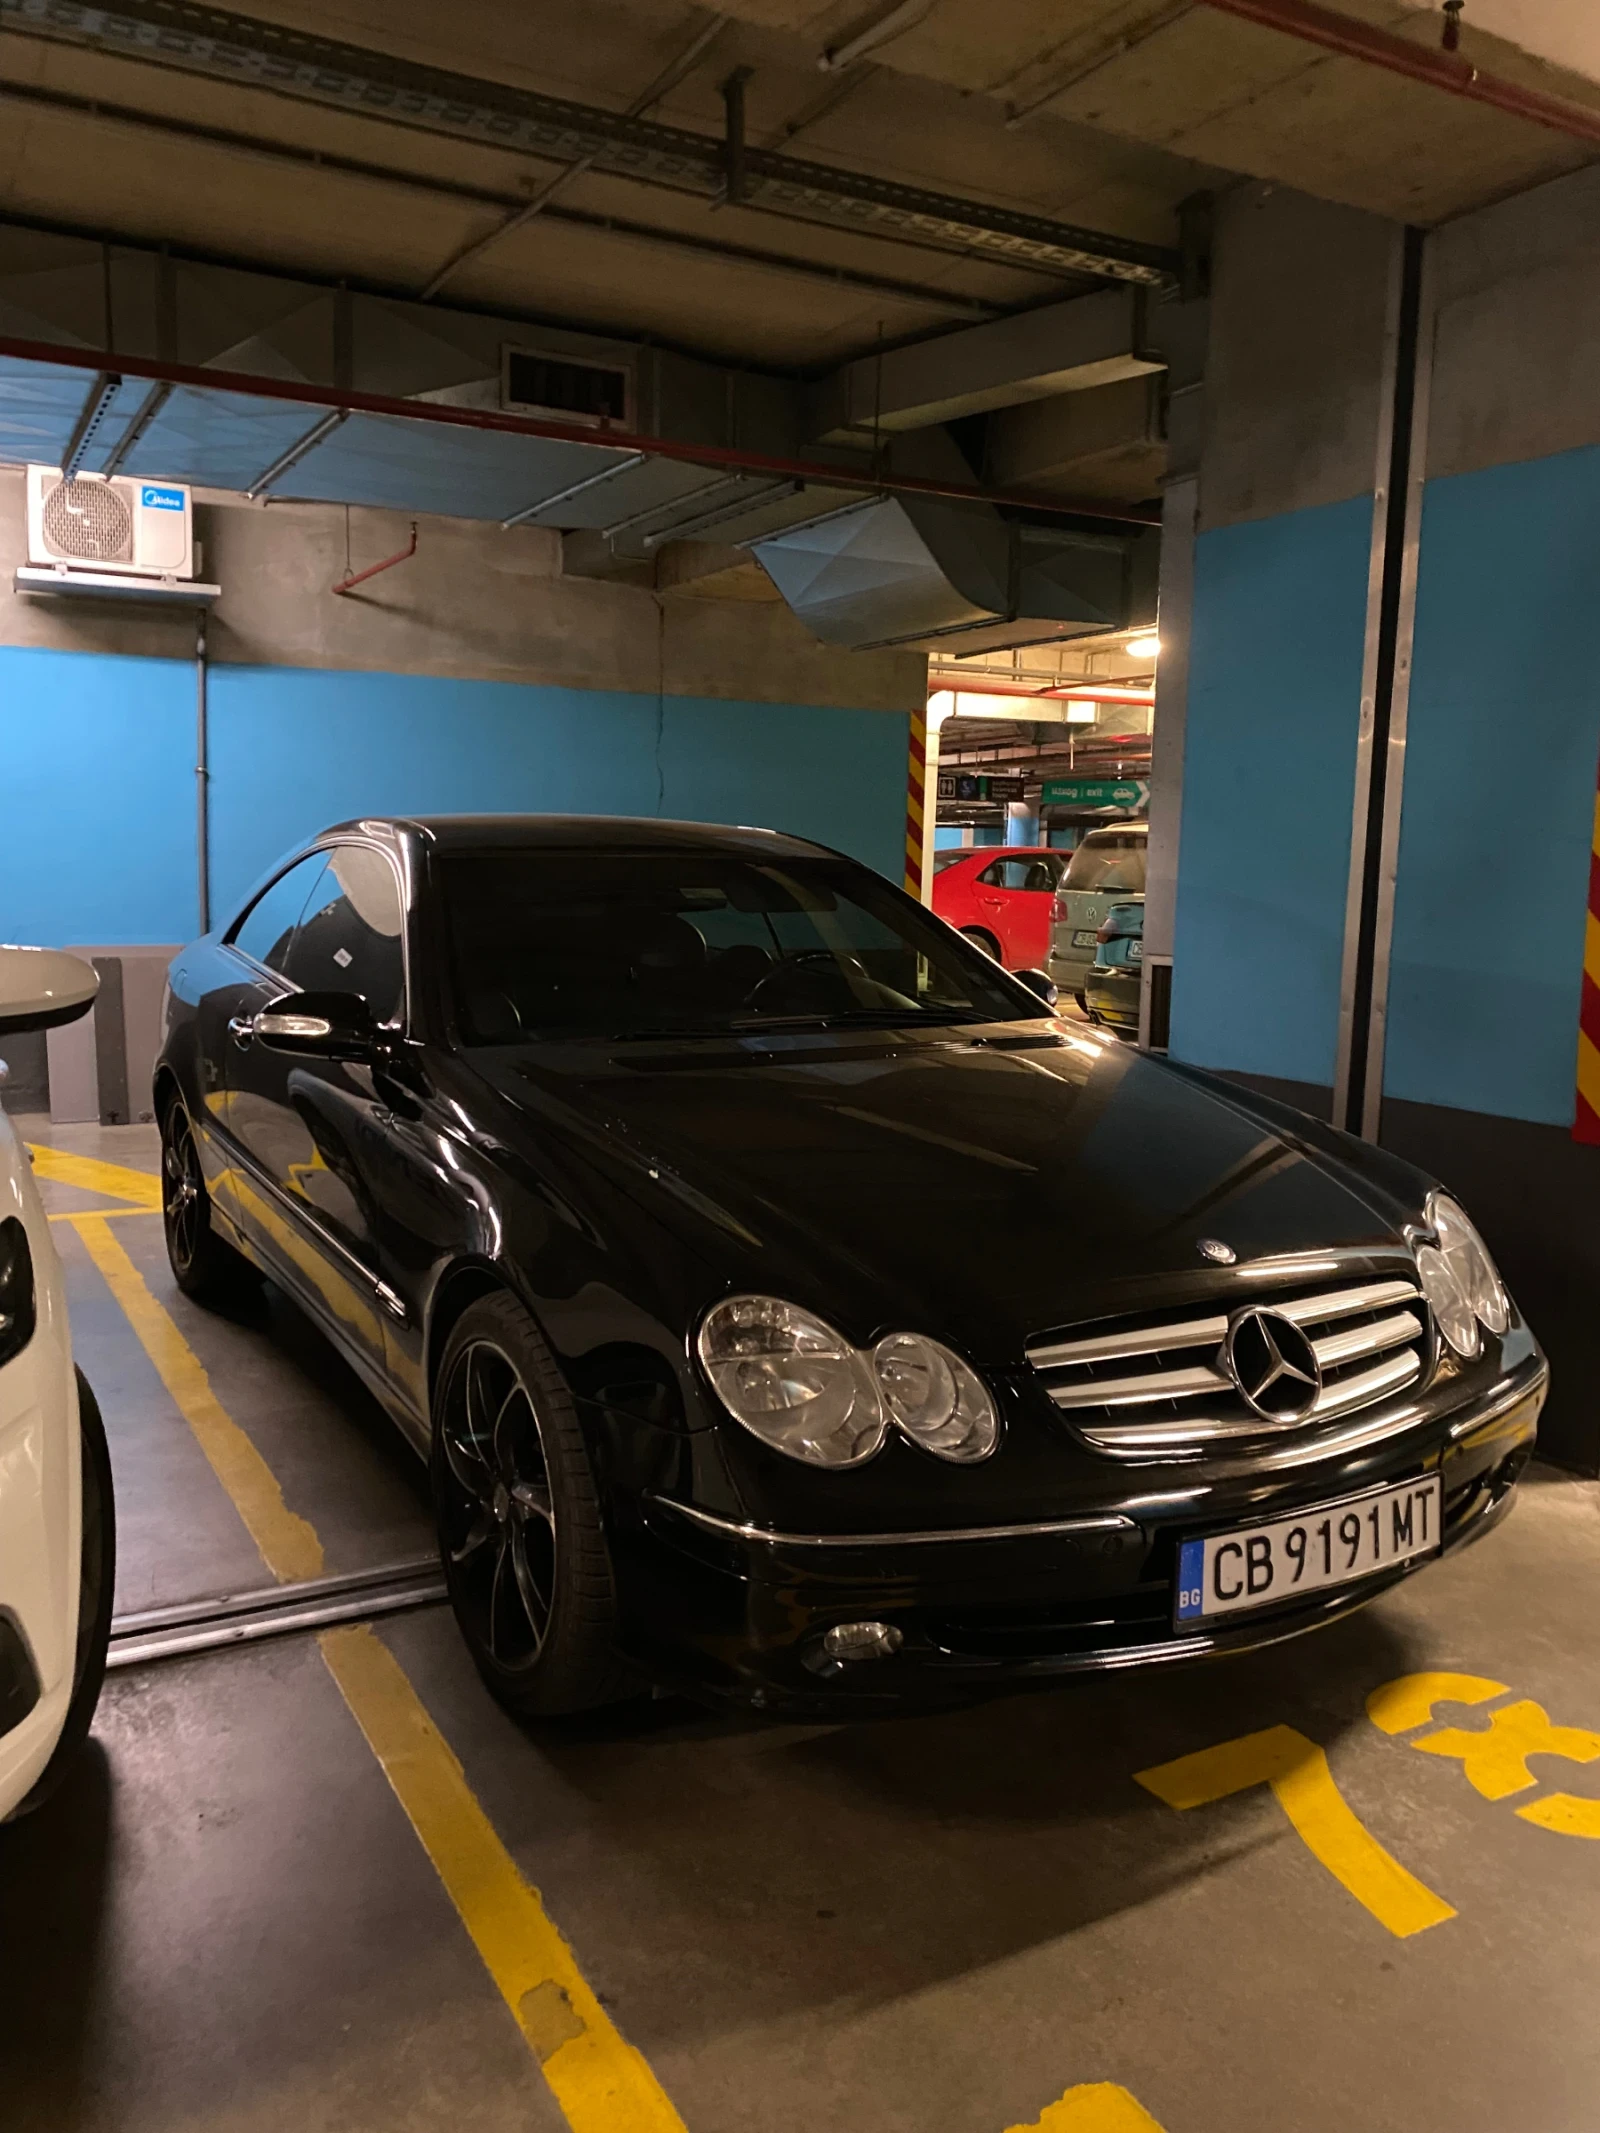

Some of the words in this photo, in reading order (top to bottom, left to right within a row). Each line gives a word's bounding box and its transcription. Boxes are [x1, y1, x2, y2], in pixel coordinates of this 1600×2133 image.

[152, 495, 181, 507] Midea
[1087, 787, 1103, 797] exit
[1180, 1588, 1201, 1608] BG
